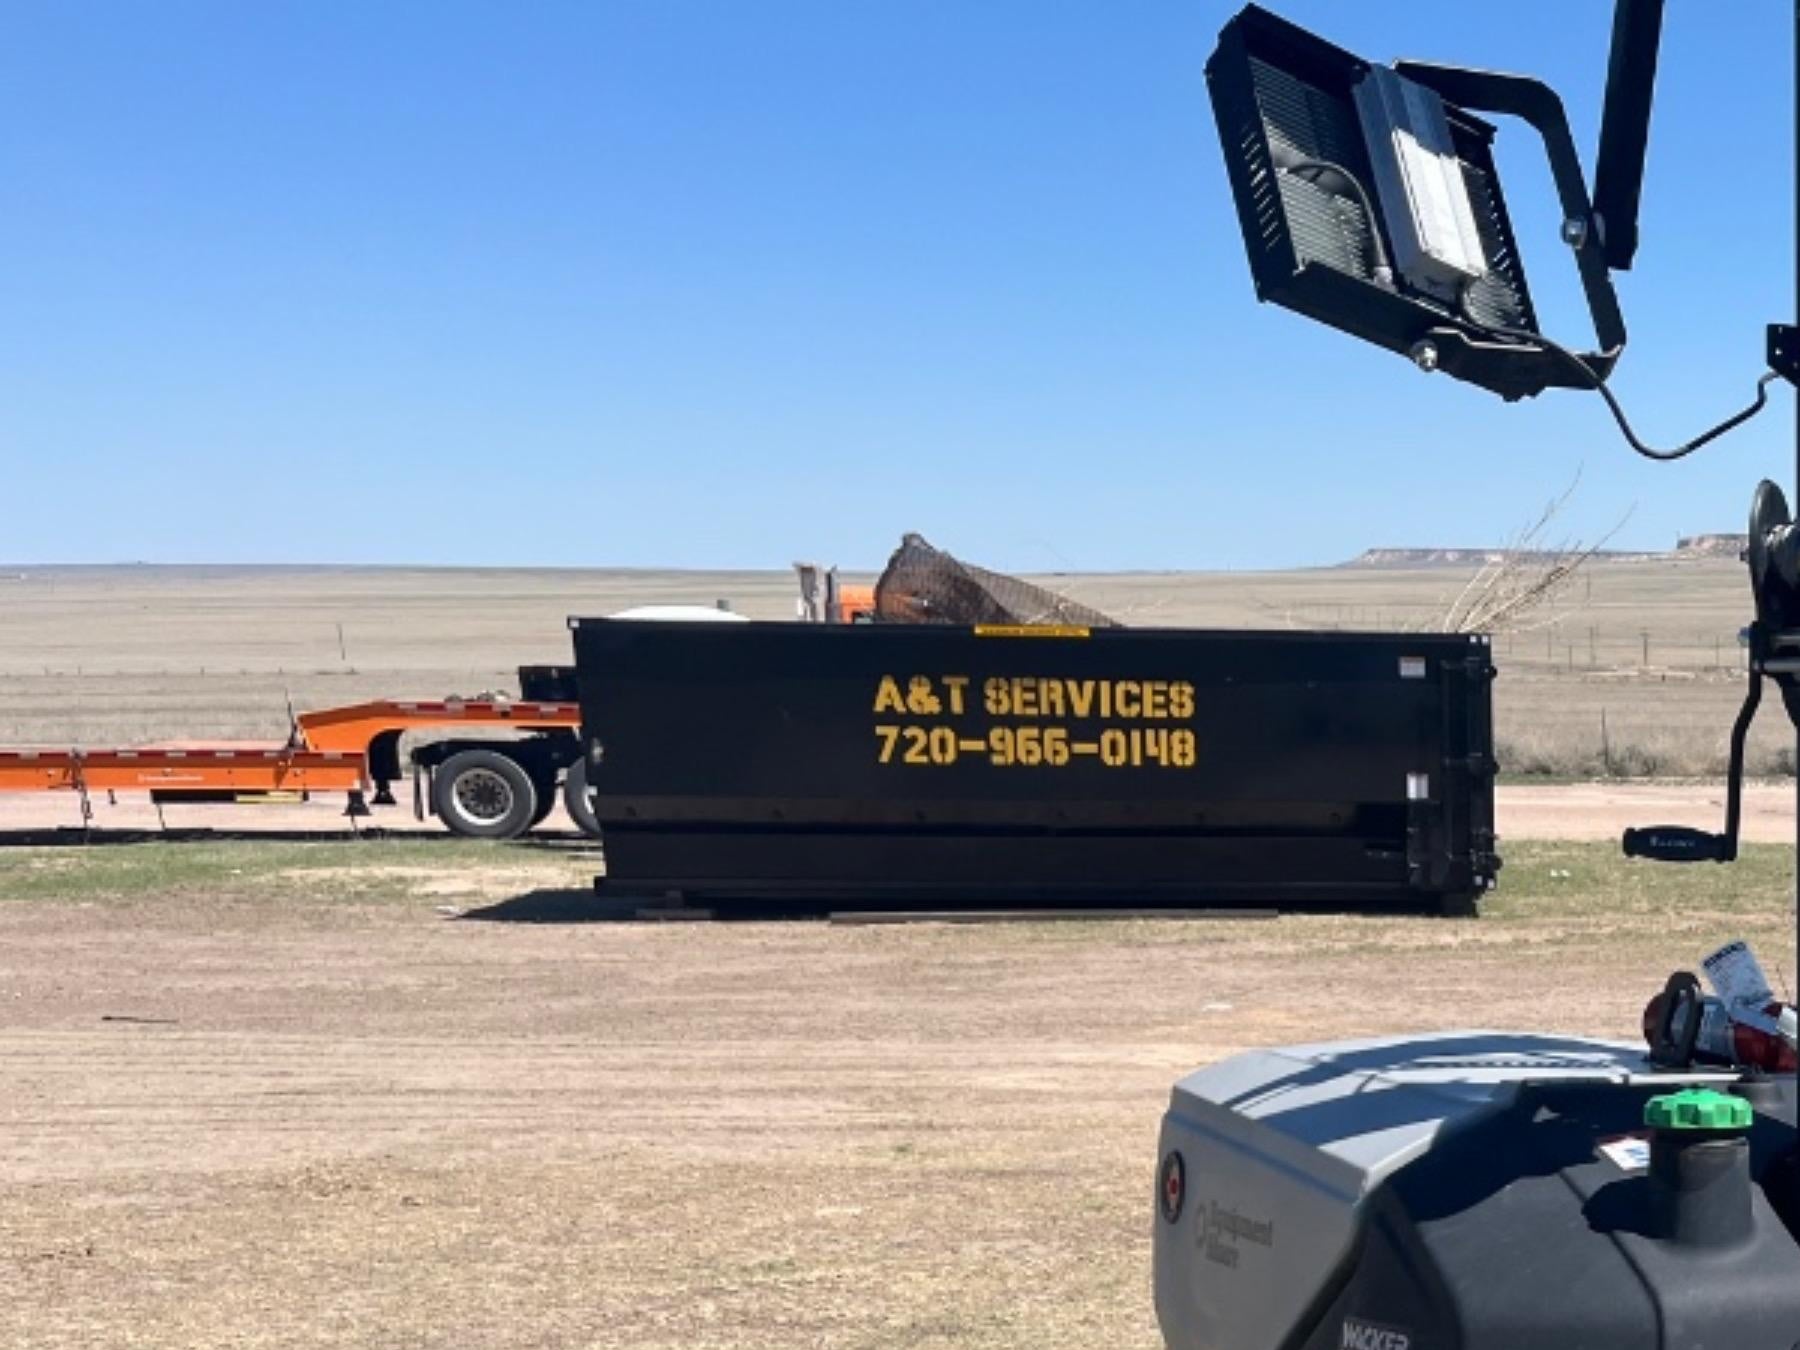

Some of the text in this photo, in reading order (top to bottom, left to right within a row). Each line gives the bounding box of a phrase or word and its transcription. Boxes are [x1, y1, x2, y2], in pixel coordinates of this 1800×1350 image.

[873, 675, 1195, 718] A&T SERVICES
[874, 725, 1195, 767] 720-966-0148
